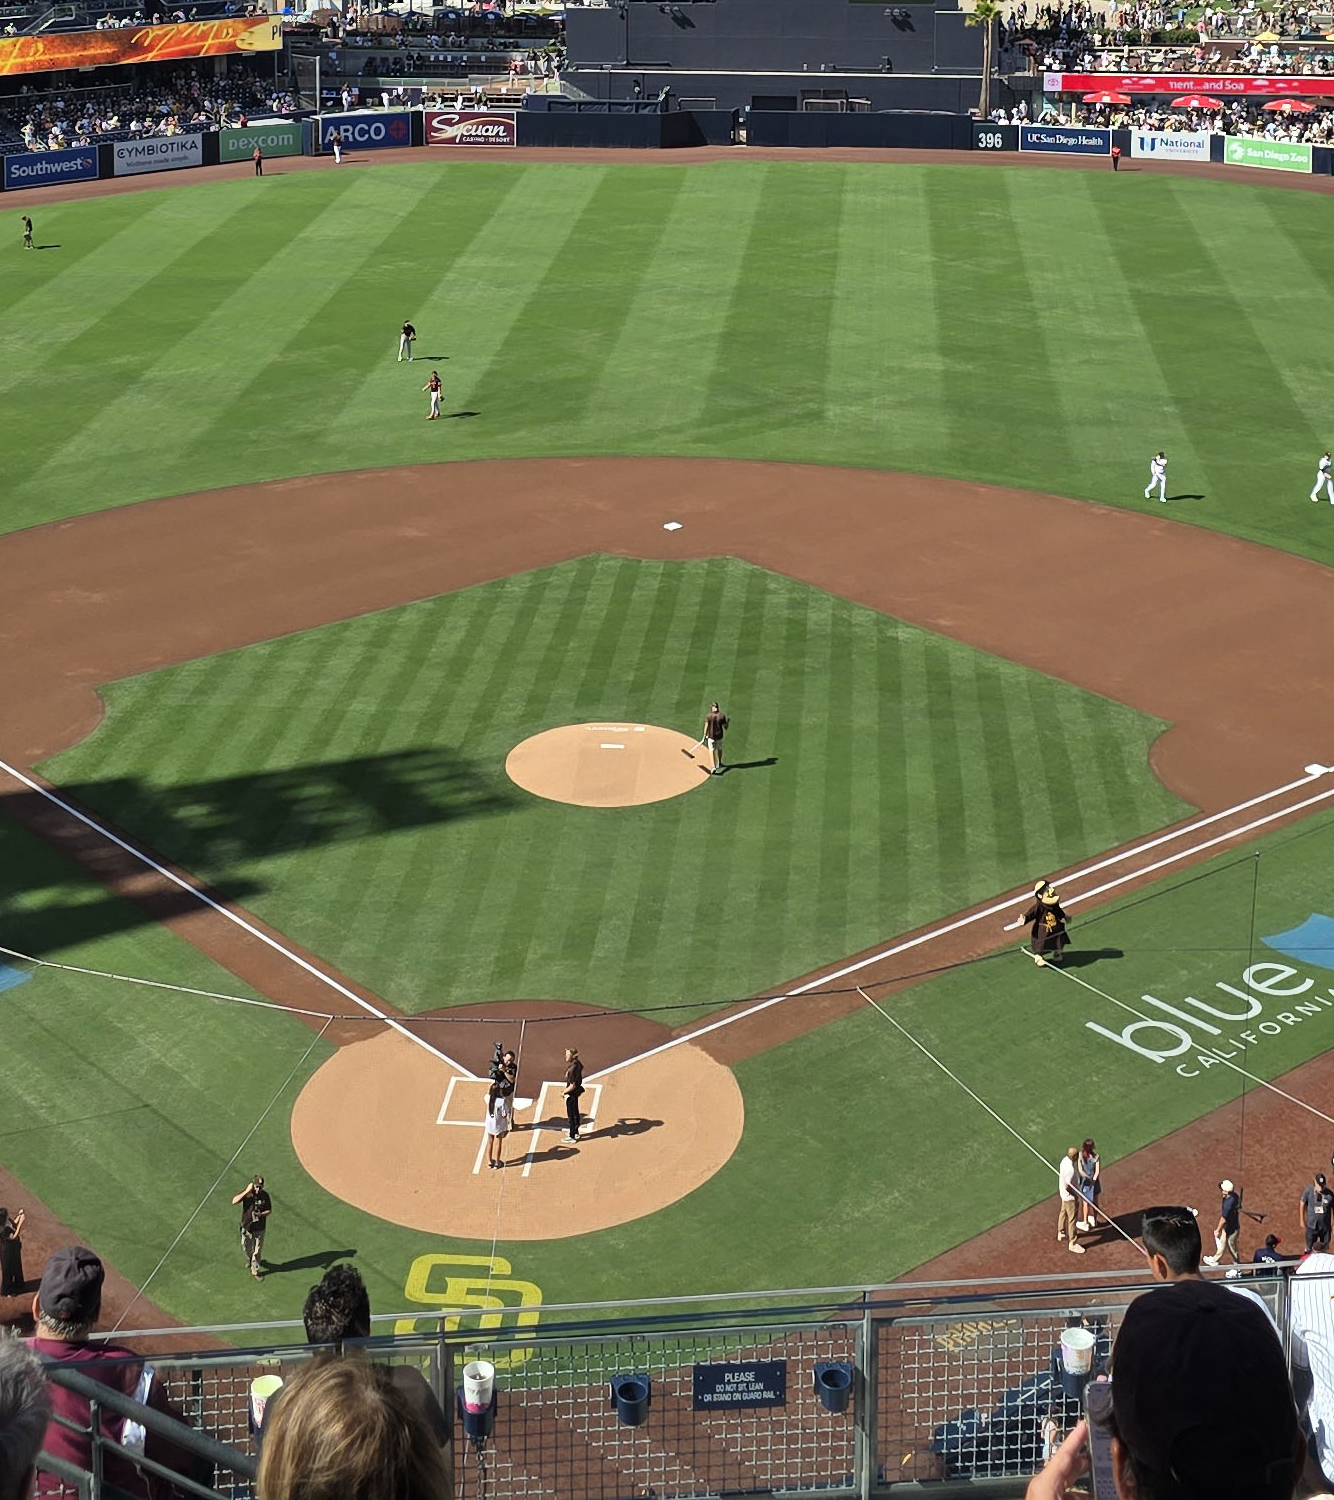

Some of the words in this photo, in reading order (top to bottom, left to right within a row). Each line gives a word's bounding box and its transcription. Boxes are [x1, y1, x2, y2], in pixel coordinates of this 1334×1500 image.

[324, 122, 386, 144] ARCO
[430, 113, 507, 143] Sycuan
[978, 132, 1003, 149] 396
[1027, 132, 1041, 143] UC
[1040, 133, 1055, 144] San
[1055, 134, 1078, 146] Diego
[1078, 135, 1104, 147] Health
[1159, 137, 1206, 149] National
[1246, 148, 1263, 158] San
[1263, 149, 1289, 162] Diego
[1288, 152, 1309, 163] Zoo
[10, 157, 83, 178] Southwest
[1085, 962, 1315, 1064] blue
[724, 1371, 756, 1383] PLEASE
[715, 1384, 725, 1392] DO
[725, 1383, 737, 1392] NOT
[748, 1382, 764, 1391] LEAN
[703, 1393, 712, 1402] OR
[712, 1393, 732, 1402] STAND
[732, 1392, 742, 1401] ON
[742, 1391, 762, 1401] GUARD
[762, 1390, 776, 1399] RAIL
